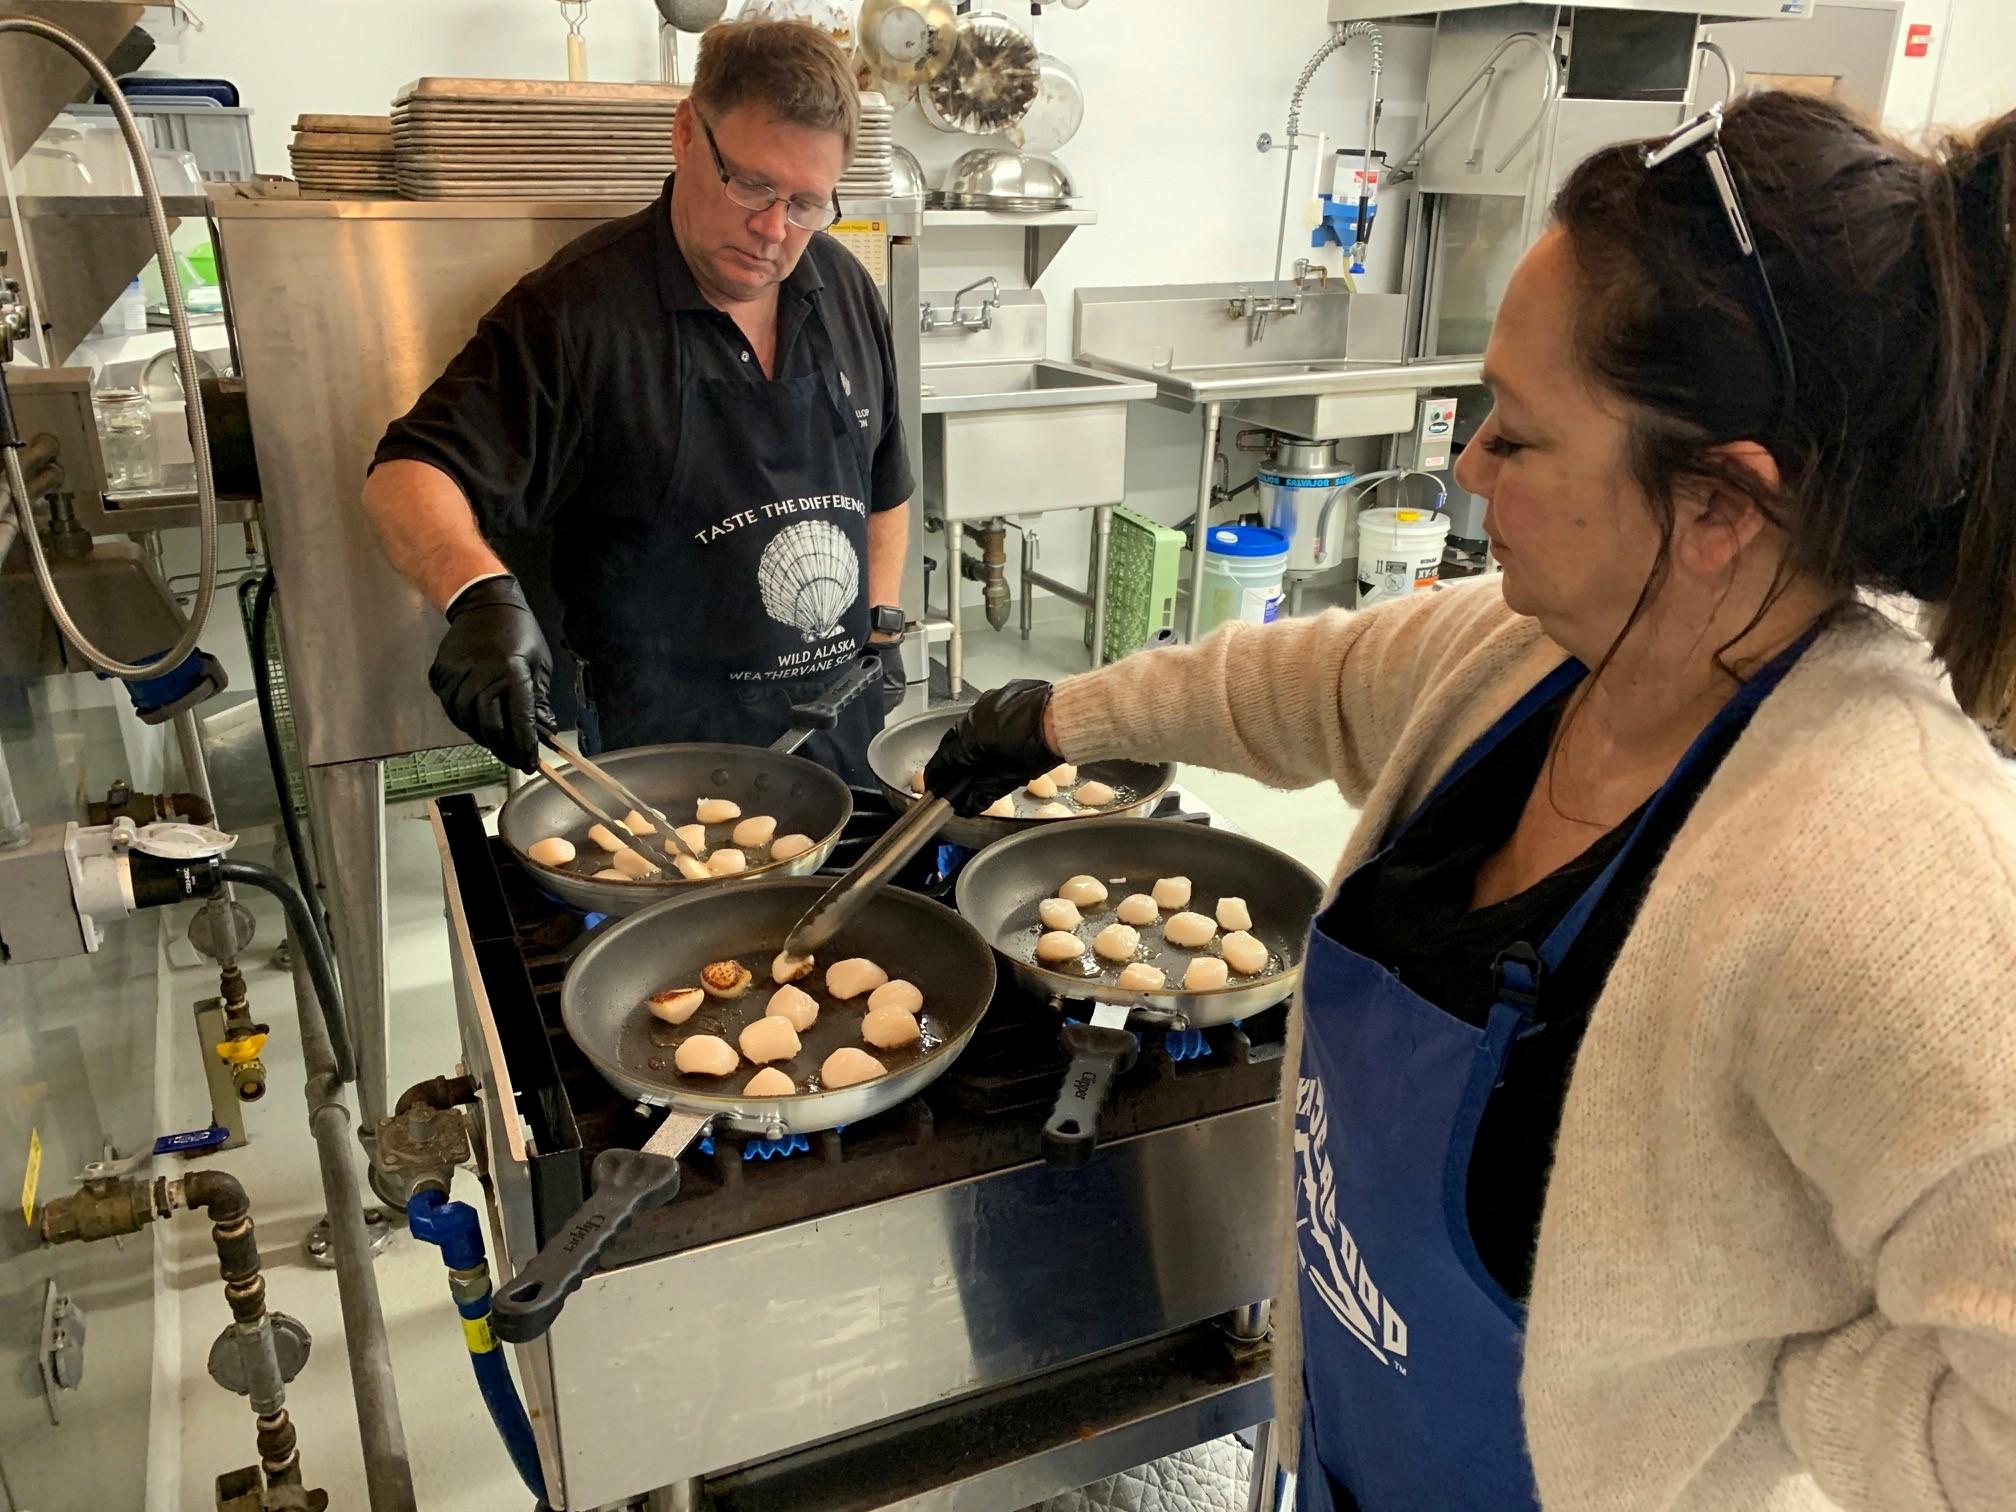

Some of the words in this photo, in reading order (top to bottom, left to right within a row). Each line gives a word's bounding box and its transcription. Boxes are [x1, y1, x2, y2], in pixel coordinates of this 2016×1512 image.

[695, 509, 758, 544] TASTE
[760, 499, 798, 519] THE
[778, 651, 812, 667] WILD
[813, 637, 856, 660] ALASKA
[729, 658, 833, 682] WEATHERVANE
[1073, 1070, 1097, 1100] Clipper
[563, 1213, 606, 1253] Clipper
